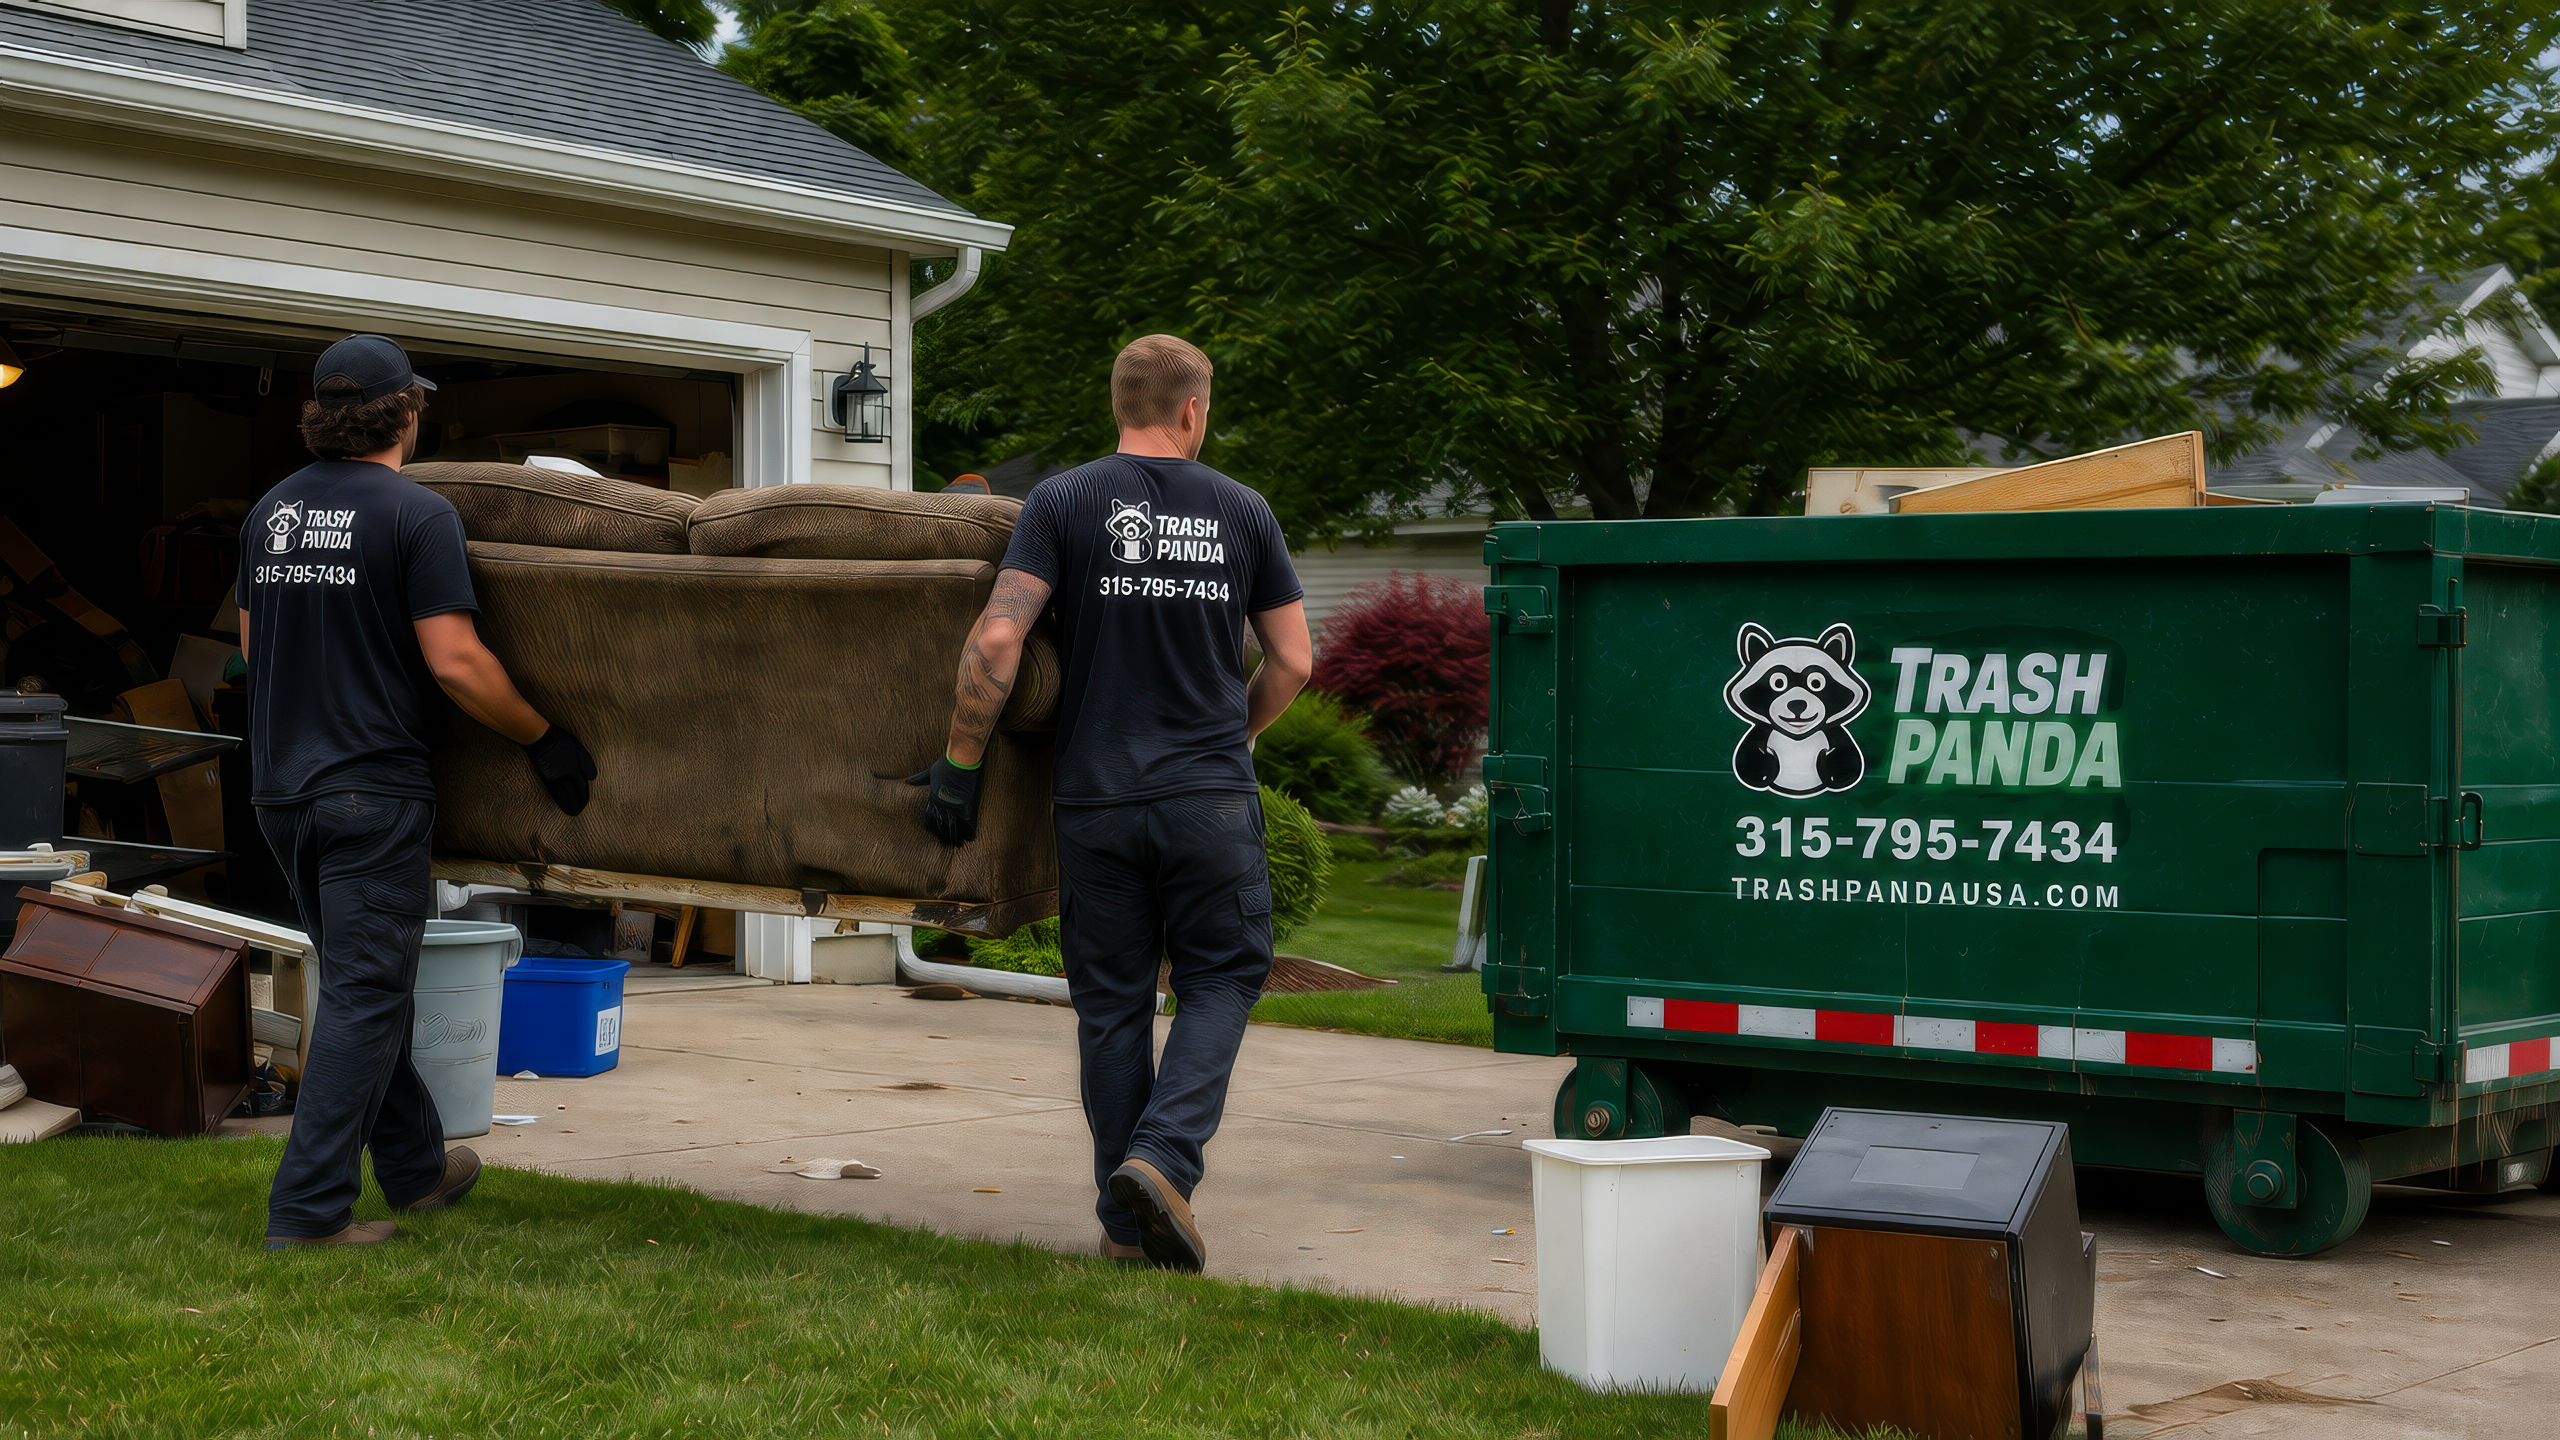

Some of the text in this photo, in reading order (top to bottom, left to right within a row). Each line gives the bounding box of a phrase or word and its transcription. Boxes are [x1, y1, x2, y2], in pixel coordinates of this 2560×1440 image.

[1156, 515, 1219, 539] TRASH
[1156, 539, 1225, 565] PANDA
[1099, 576, 1230, 602] 315-795-7434
[1890, 647, 2108, 715] TRASH
[1888, 720, 2122, 788] PANDA
[1735, 816, 2118, 863] 315-795-7434
[1731, 877, 2119, 908] TRASHPANDAUSA.COM
